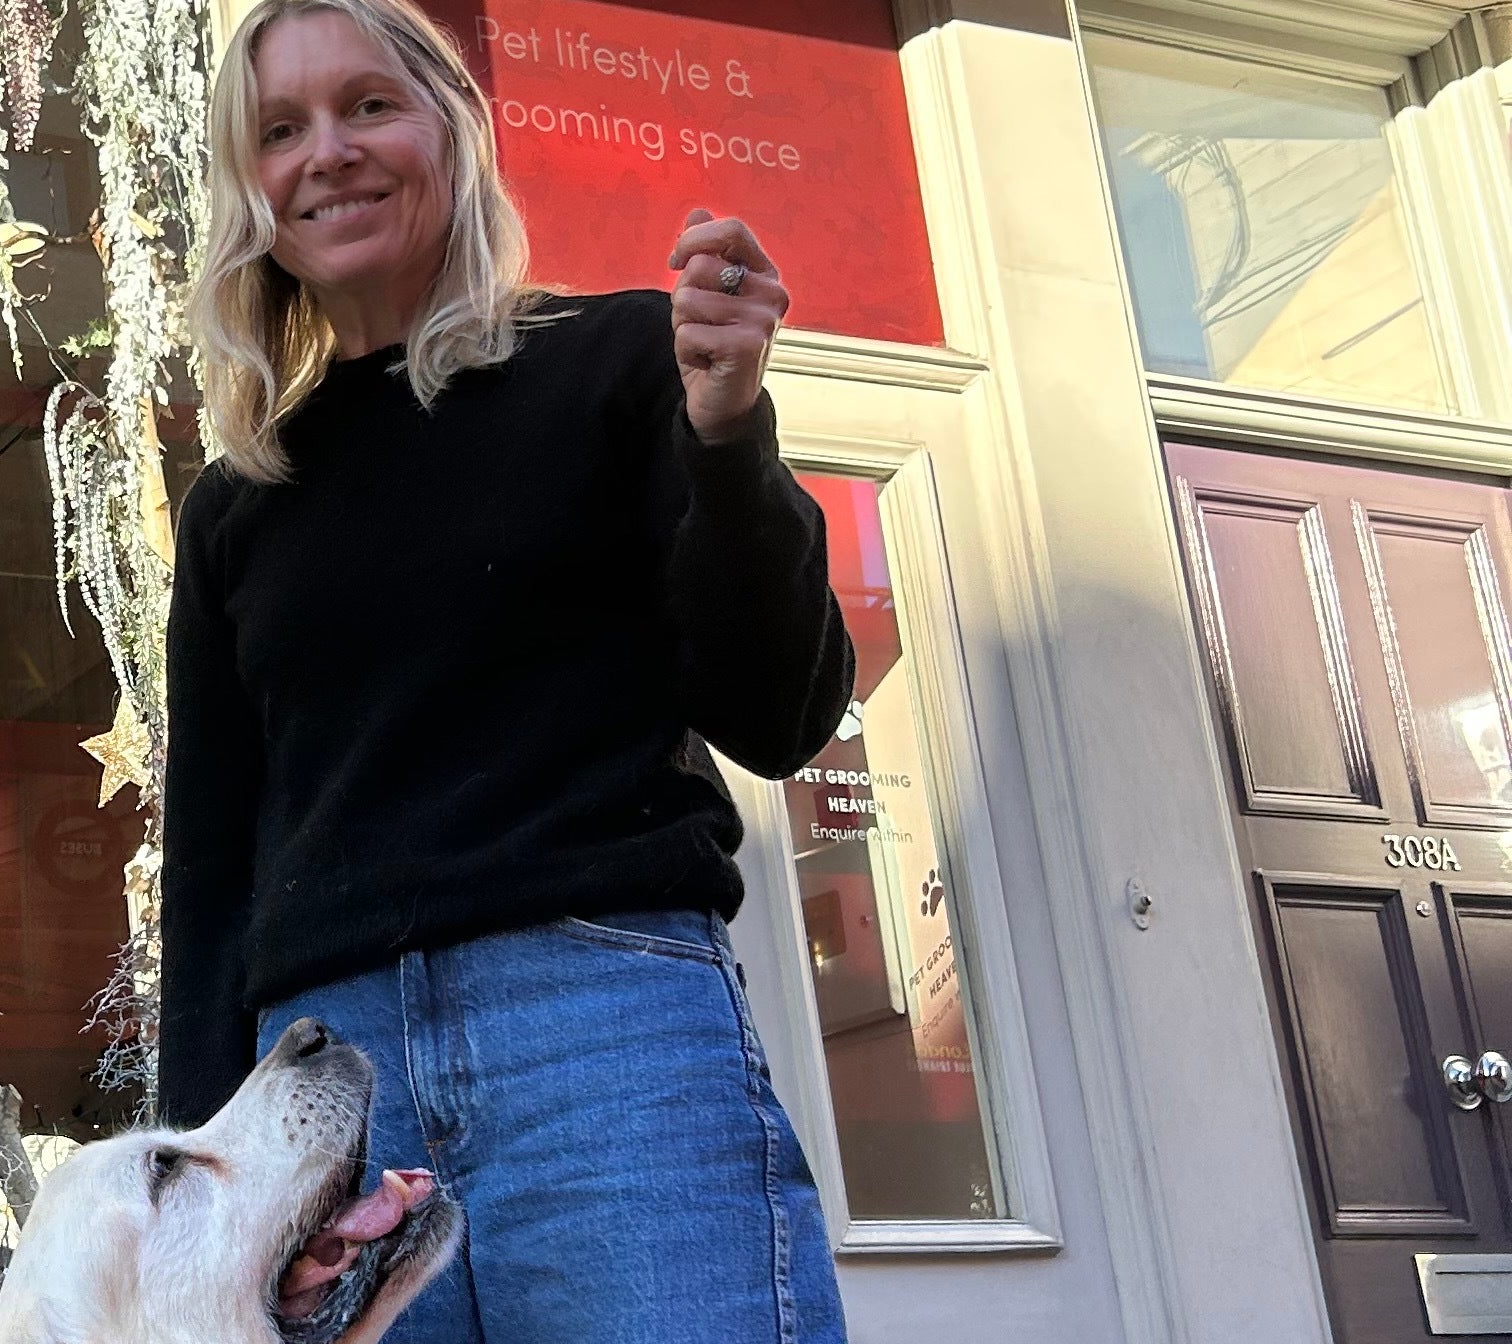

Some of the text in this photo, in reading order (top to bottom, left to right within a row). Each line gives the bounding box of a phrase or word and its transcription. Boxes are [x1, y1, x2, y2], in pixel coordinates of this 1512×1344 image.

[474, 15, 753, 98] Pet lifestyle &
[488, 97, 801, 172] rooming space
[825, 769, 912, 788] GROOMING
[827, 796, 887, 814] HEAVEN
[810, 822, 867, 844] Enquire
[1381, 834, 1462, 872] 308A
